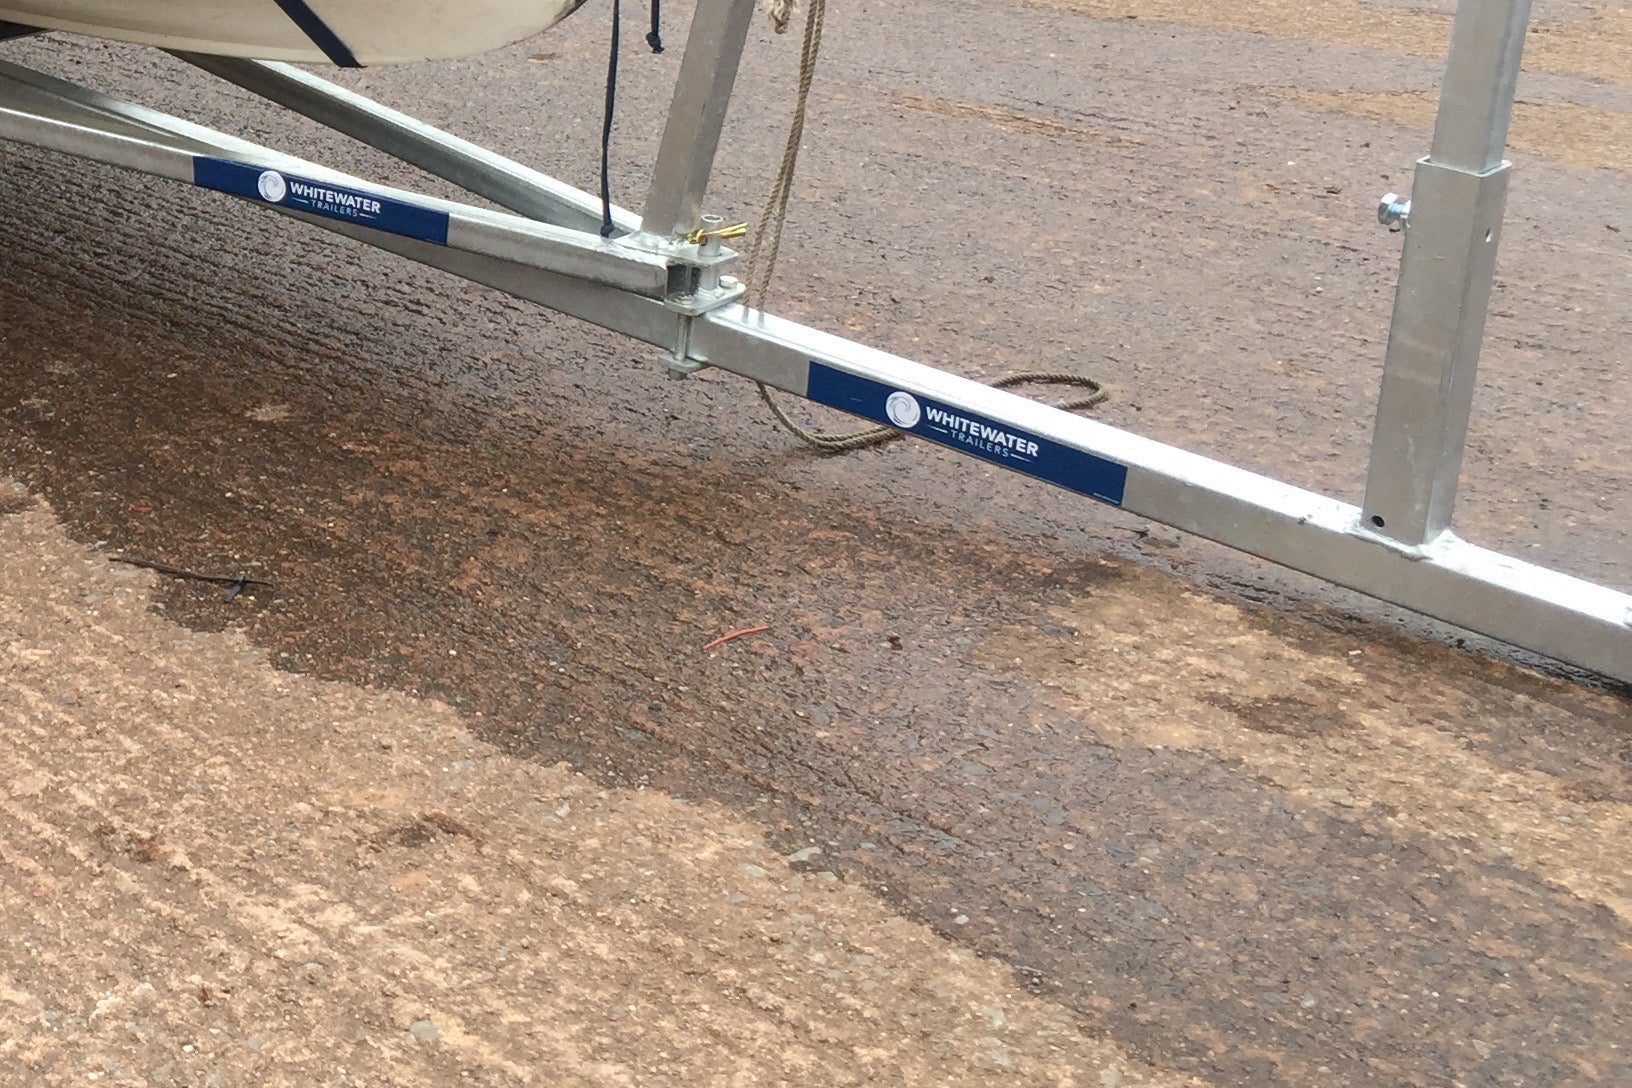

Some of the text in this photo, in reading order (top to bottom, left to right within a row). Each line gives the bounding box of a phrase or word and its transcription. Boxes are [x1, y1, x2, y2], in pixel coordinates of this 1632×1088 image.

[290, 181, 381, 214] WHITEWATER
[311, 199, 358, 217] TRAILERS
[926, 406, 1039, 457] WHITEWATER
[950, 429, 1009, 458] TRAILERS
